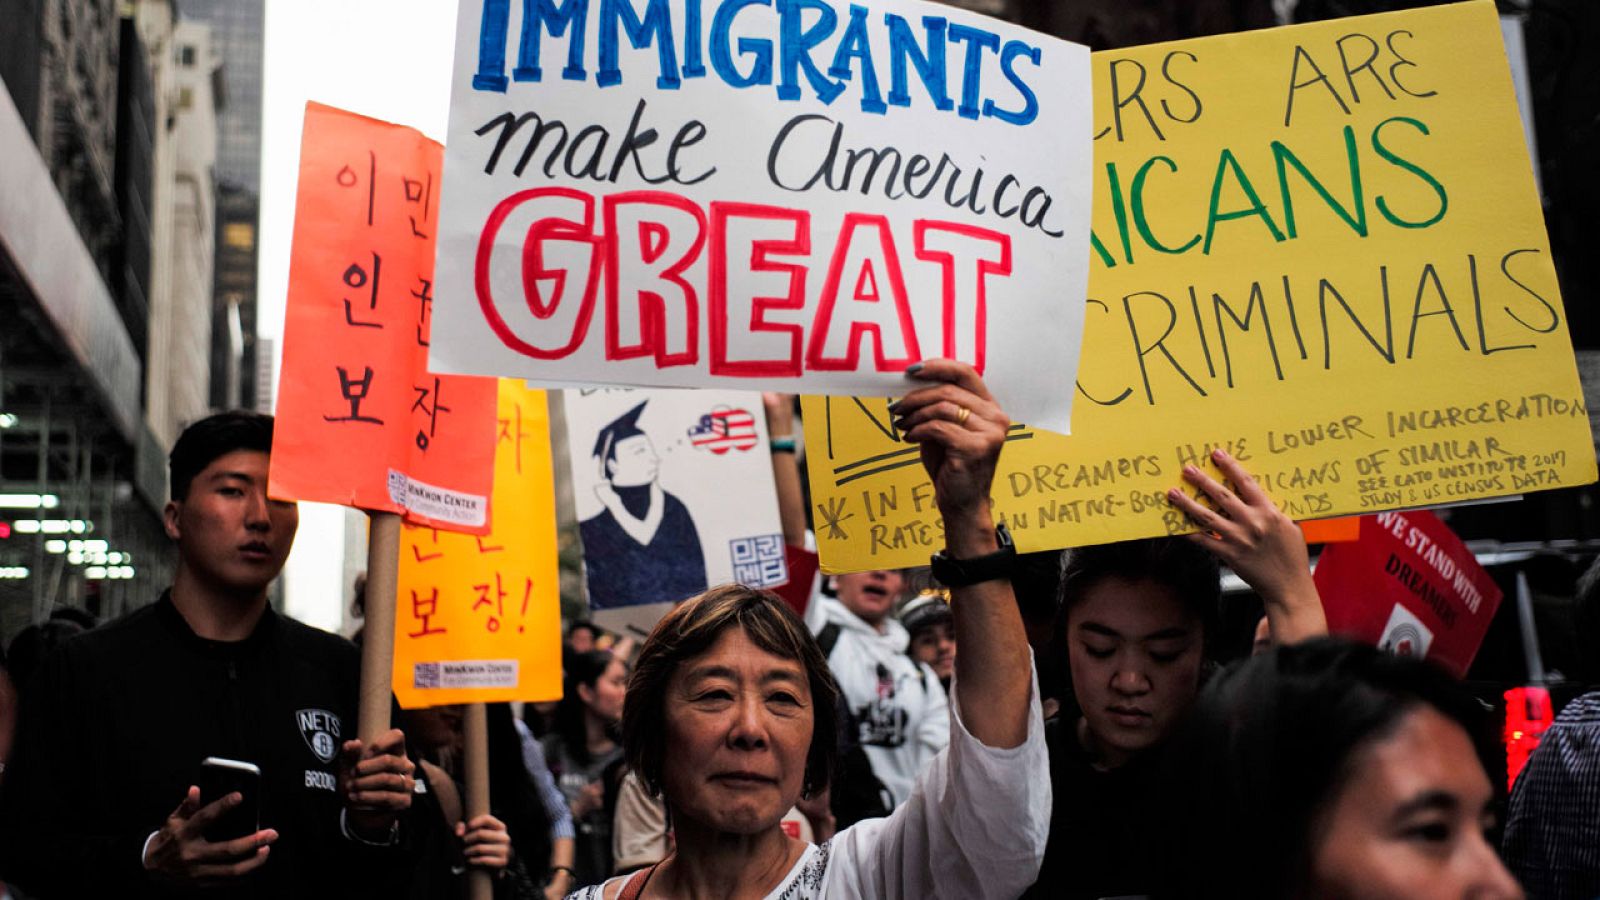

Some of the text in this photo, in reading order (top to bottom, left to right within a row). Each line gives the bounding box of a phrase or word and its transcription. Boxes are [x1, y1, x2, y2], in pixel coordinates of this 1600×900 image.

[472, 0, 1042, 126] IMMIGRANTS
[1093, 30, 1438, 142] RS ARE
[475, 99, 717, 185] make
[1091, 117, 1449, 268] ICANS
[475, 187, 1013, 378] GREAT
[862, 485, 897, 522] IN
[1268, 415, 1375, 455] LOWER
[1356, 448, 1391, 476] OF
[1399, 437, 1512, 466] SIMILAR
[1358, 477, 1389, 493] SEE
[1394, 470, 1432, 488] CATO
[1424, 483, 1441, 500] US
[1446, 475, 1505, 496] CENSUS
[1511, 469, 1562, 490] DATA
[1377, 512, 1483, 615] WE STAND WITH
[301, 711, 341, 738] NETS
